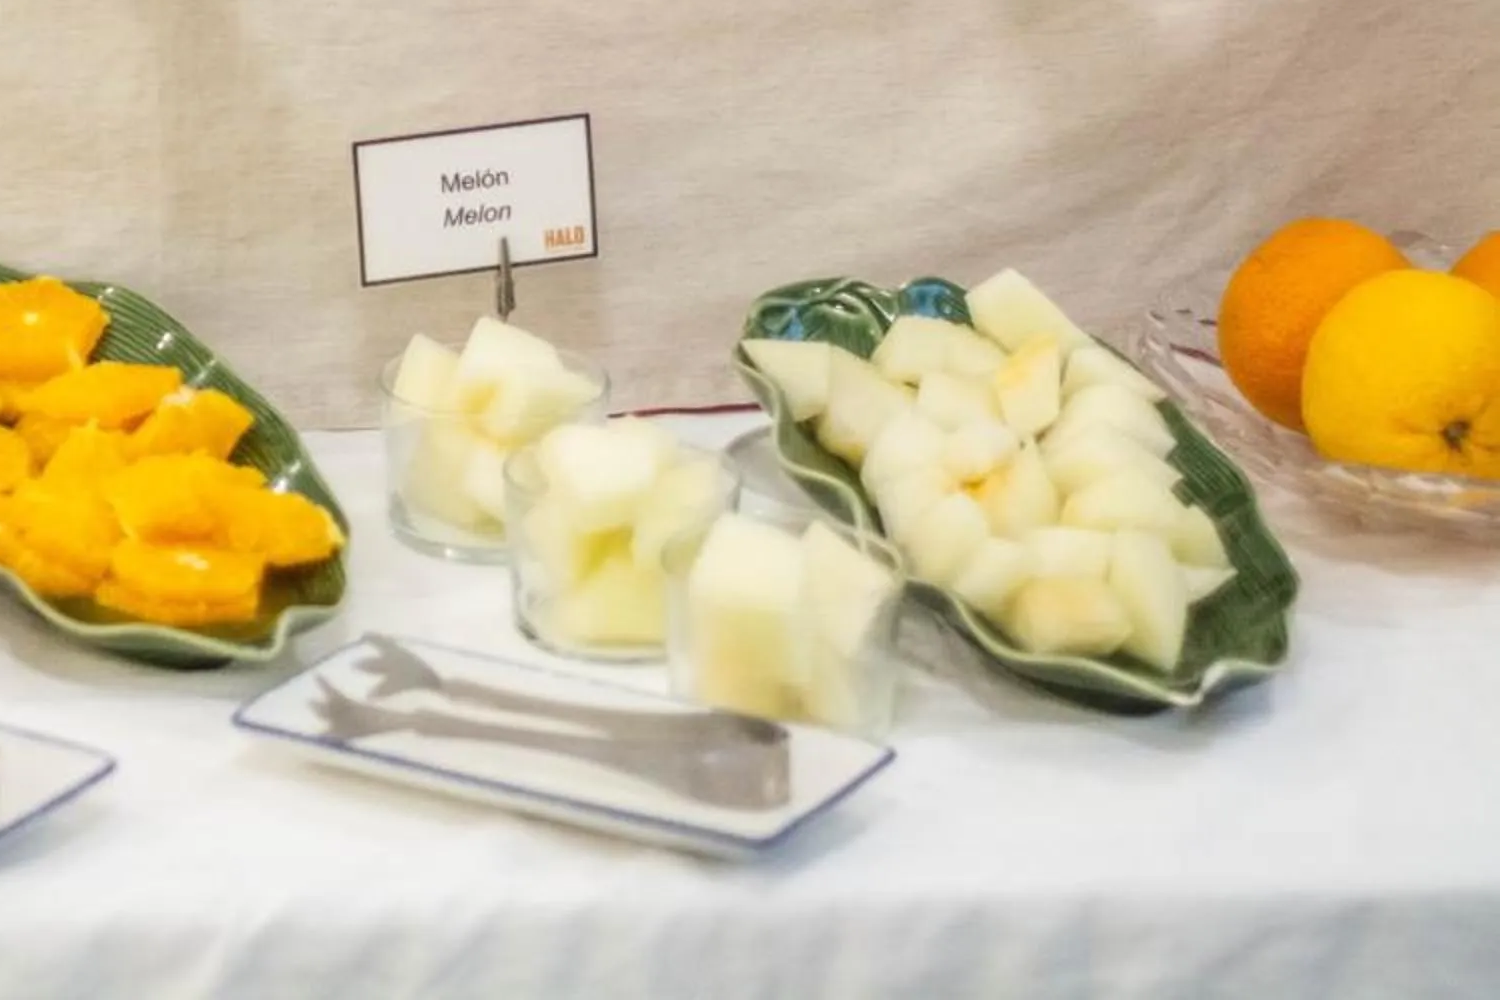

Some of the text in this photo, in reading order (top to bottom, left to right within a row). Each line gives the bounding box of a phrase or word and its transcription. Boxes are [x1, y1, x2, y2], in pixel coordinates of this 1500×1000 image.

[441, 168, 510, 193] Melón
[443, 204, 512, 228] Melon
[544, 226, 585, 247] HALO
